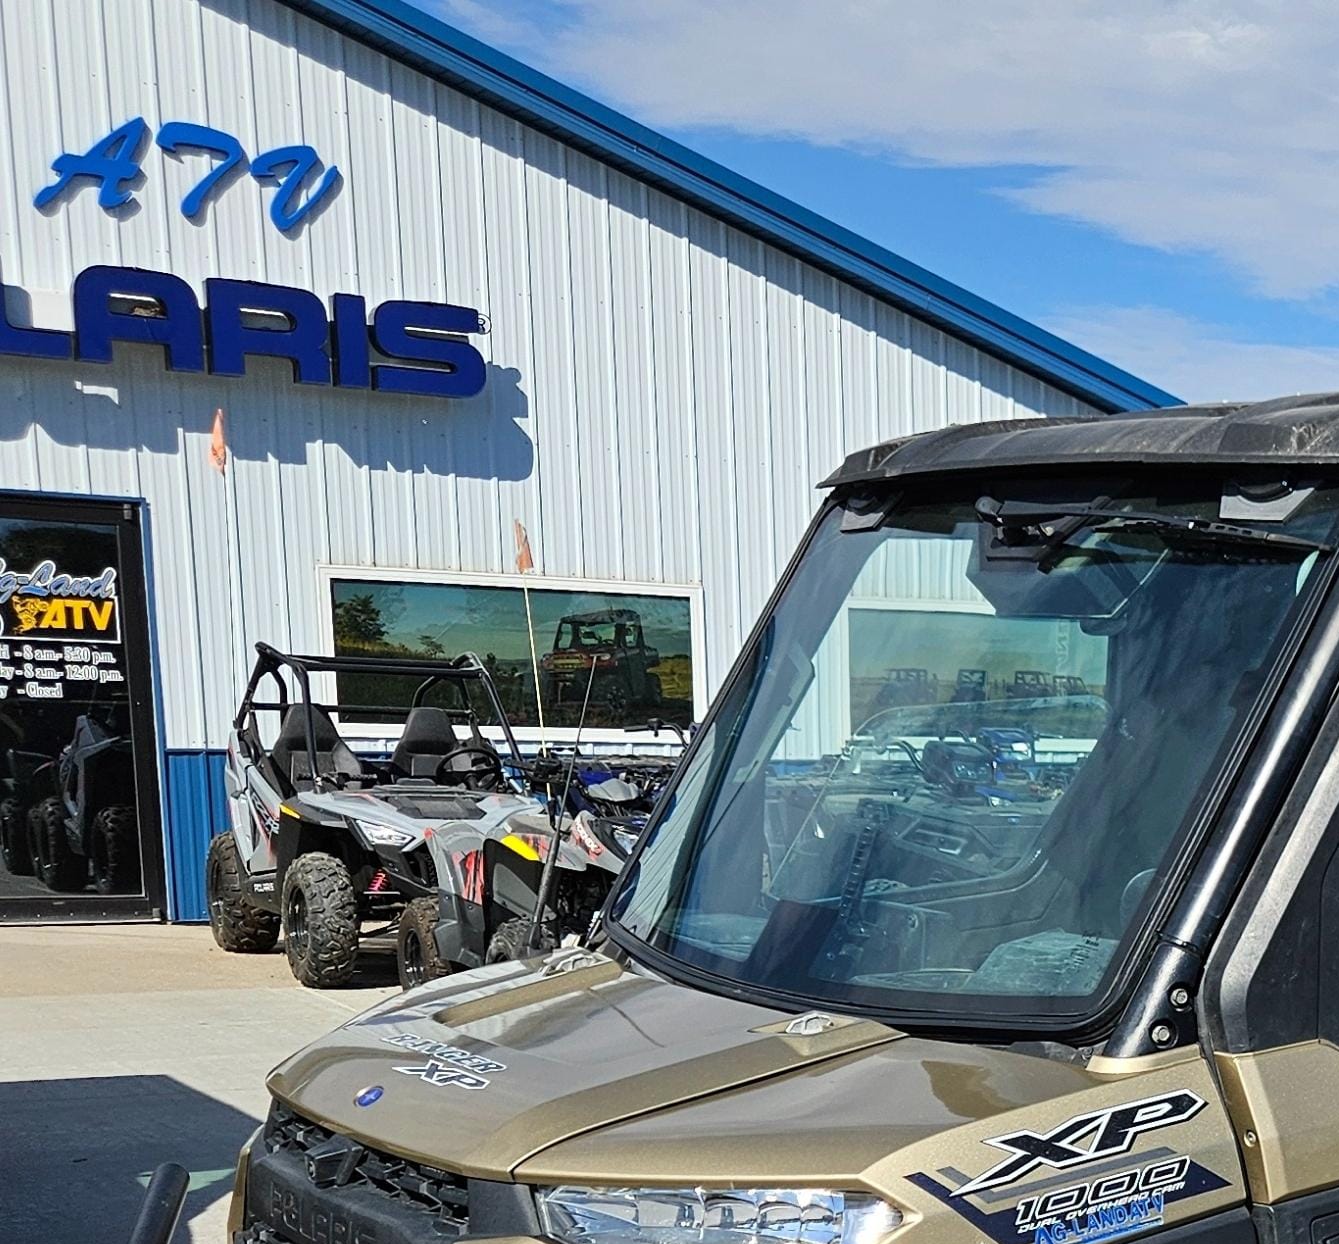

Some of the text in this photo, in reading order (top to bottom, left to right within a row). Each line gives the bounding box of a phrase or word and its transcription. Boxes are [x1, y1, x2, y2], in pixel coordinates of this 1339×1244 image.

[33, 116, 342, 234] ATV
[0, 558, 117, 604] g-Land
[39, 598, 114, 631] ATV
[26, 681, 64, 699] Closed
[391, 1060, 490, 1090] XP
[949, 1088, 1209, 1198] XP
[1015, 1154, 1191, 1227] 1000
